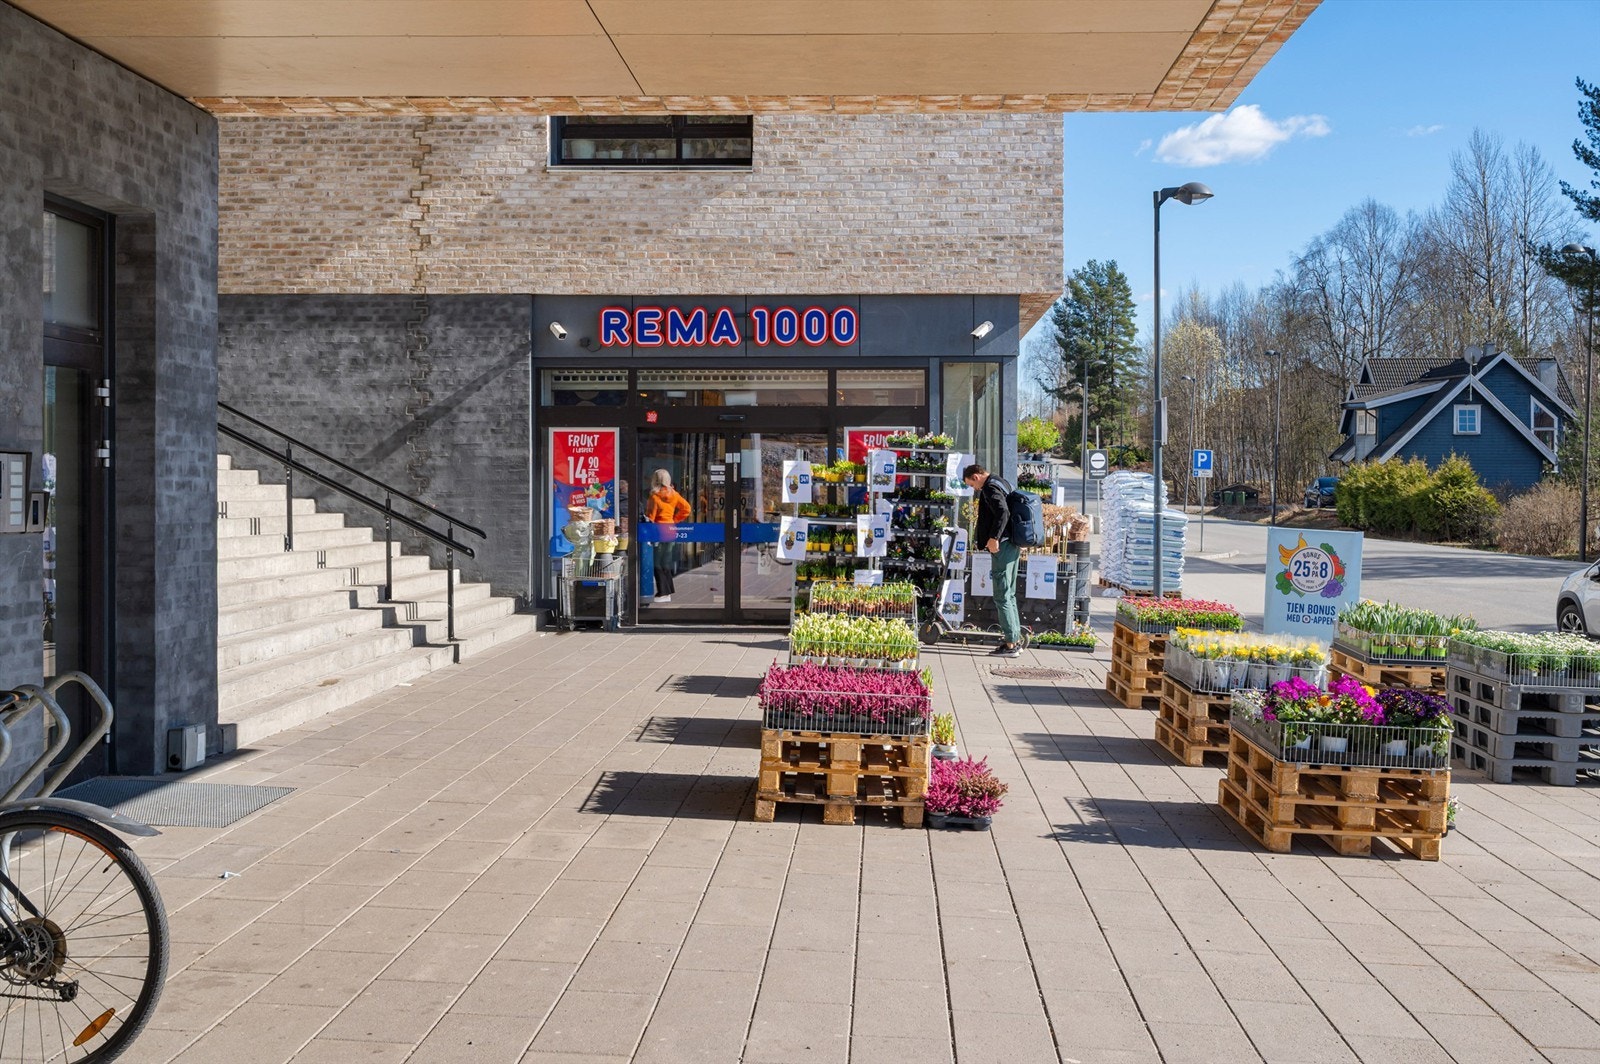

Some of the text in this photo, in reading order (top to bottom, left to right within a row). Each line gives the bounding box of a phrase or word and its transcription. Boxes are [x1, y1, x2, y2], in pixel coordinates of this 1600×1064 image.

[600, 306, 859, 347] REMA 1000
[568, 434, 599, 447] FRUKT
[863, 434, 889, 448] FRUK
[1198, 453, 1208, 467] P
[567, 456, 599, 485] 14 90
[1294, 560, 1319, 577] 25 %
[1320, 562, 1328, 578] 8
[1287, 602, 1336, 615] TJEN BONUS
[1287, 614, 1300, 623] MED
